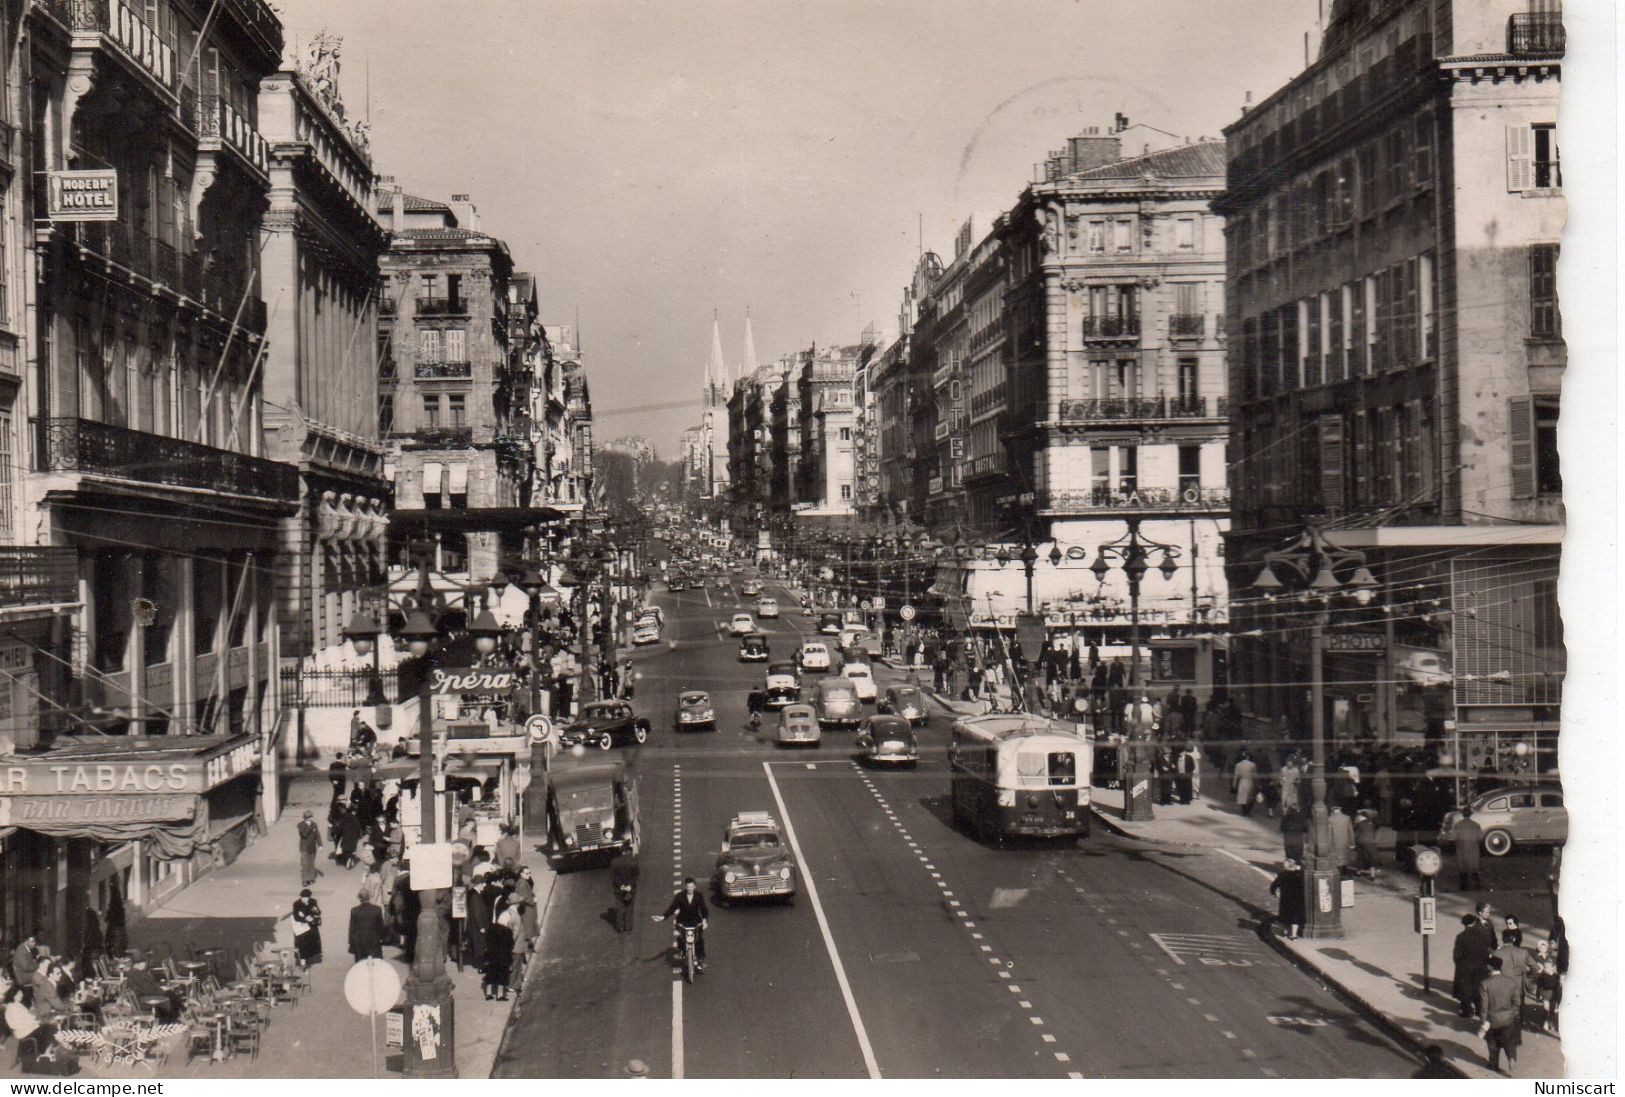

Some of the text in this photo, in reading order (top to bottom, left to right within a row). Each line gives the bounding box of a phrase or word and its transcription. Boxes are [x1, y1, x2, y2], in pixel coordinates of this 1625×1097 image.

[950, 350, 963, 487] HOTEL
[1329, 634, 1384, 649] PHOTO
[50, 763, 188, 792] TABACS
